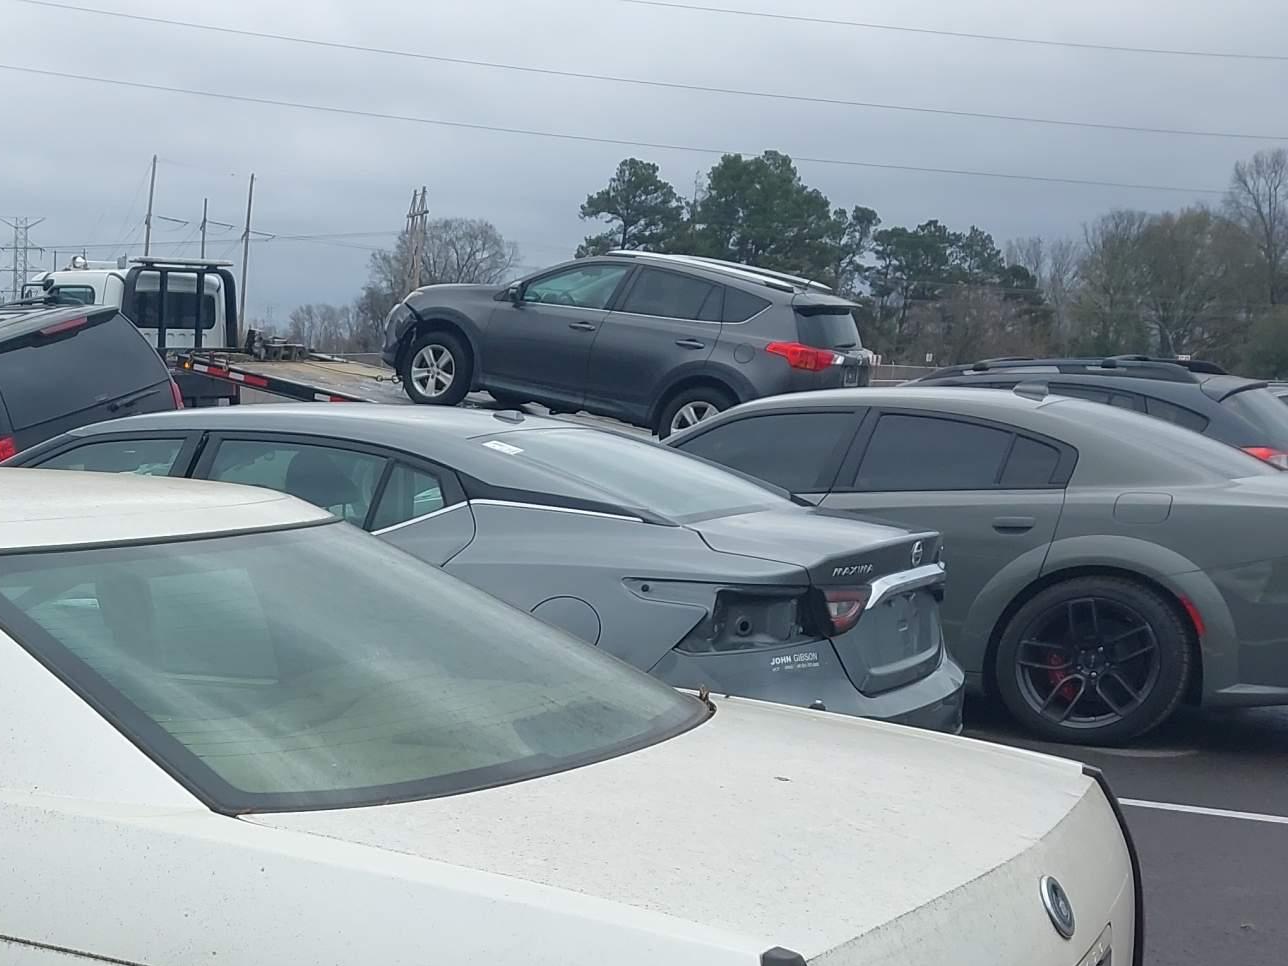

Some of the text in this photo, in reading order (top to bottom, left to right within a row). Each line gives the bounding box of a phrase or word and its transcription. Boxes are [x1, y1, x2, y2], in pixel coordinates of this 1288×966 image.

[832, 564, 873, 577] MAXIMA
[770, 652, 818, 666] JOHN GIBSON
